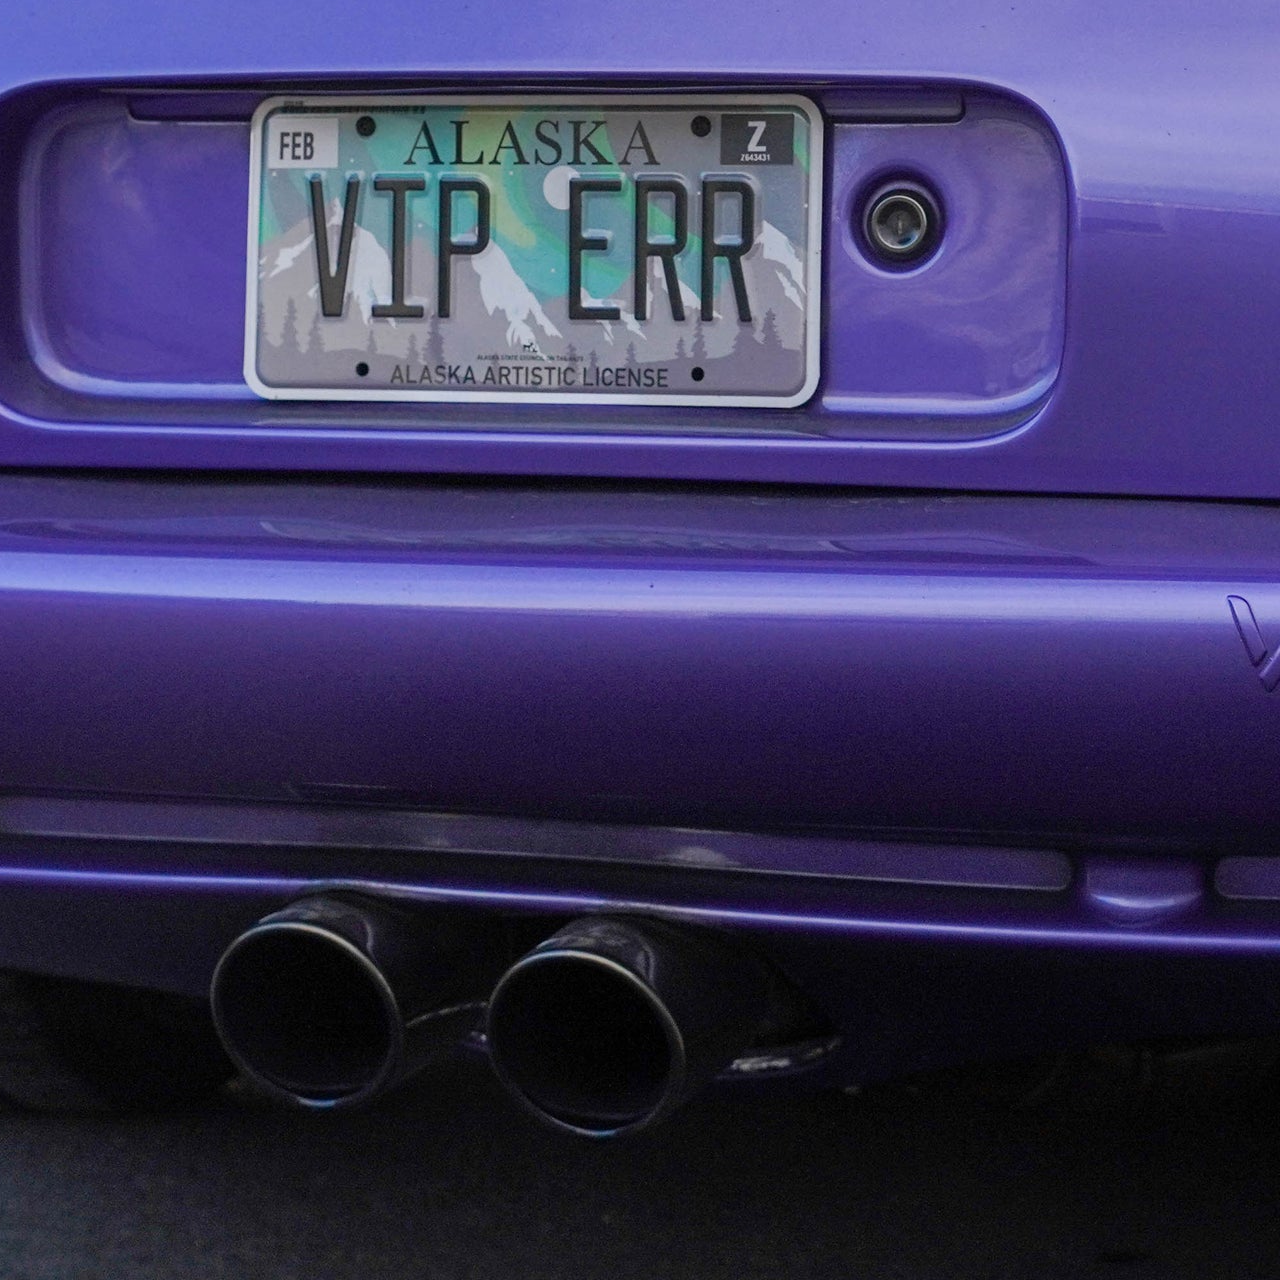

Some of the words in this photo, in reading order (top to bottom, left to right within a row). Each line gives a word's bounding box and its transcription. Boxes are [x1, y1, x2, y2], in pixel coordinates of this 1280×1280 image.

[279, 131, 314, 161] FEB
[403, 120, 660, 166] ALASKA
[747, 121, 767, 152] Z
[307, 173, 491, 318] VIP
[568, 175, 757, 322] ERR
[390, 365, 476, 385] ALASKA
[483, 366, 576, 386] ARTISTIC
[583, 367, 669, 388] LICENSE
